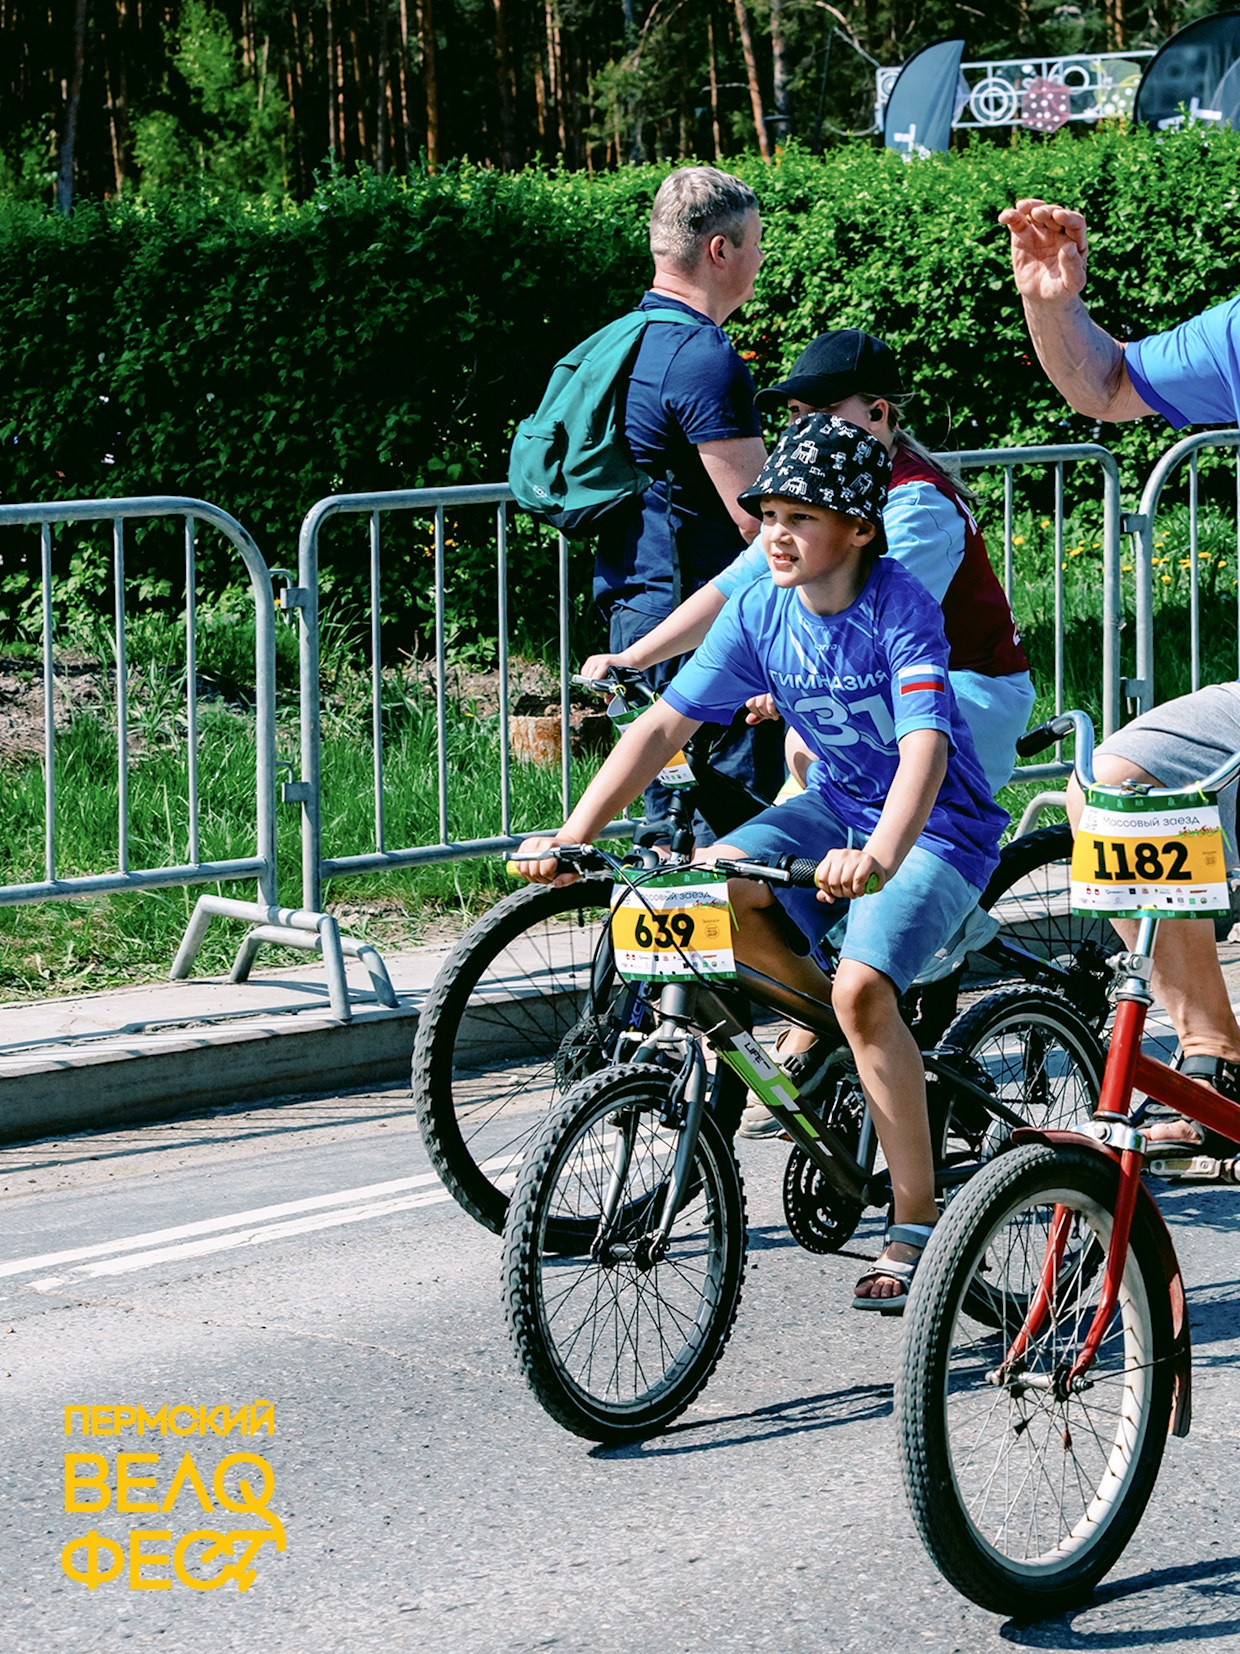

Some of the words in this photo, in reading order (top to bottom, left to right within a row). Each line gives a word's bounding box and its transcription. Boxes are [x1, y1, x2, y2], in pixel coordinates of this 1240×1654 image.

[768, 669, 891, 692] ГИМНАЗИЯ
[794, 693, 896, 747] 31
[1163, 816, 1200, 826] заезд
[1093, 840, 1193, 881] 1182
[680, 891, 711, 901] заезд
[635, 912, 695, 948] 639
[744, 1042, 763, 1064] LIFE
